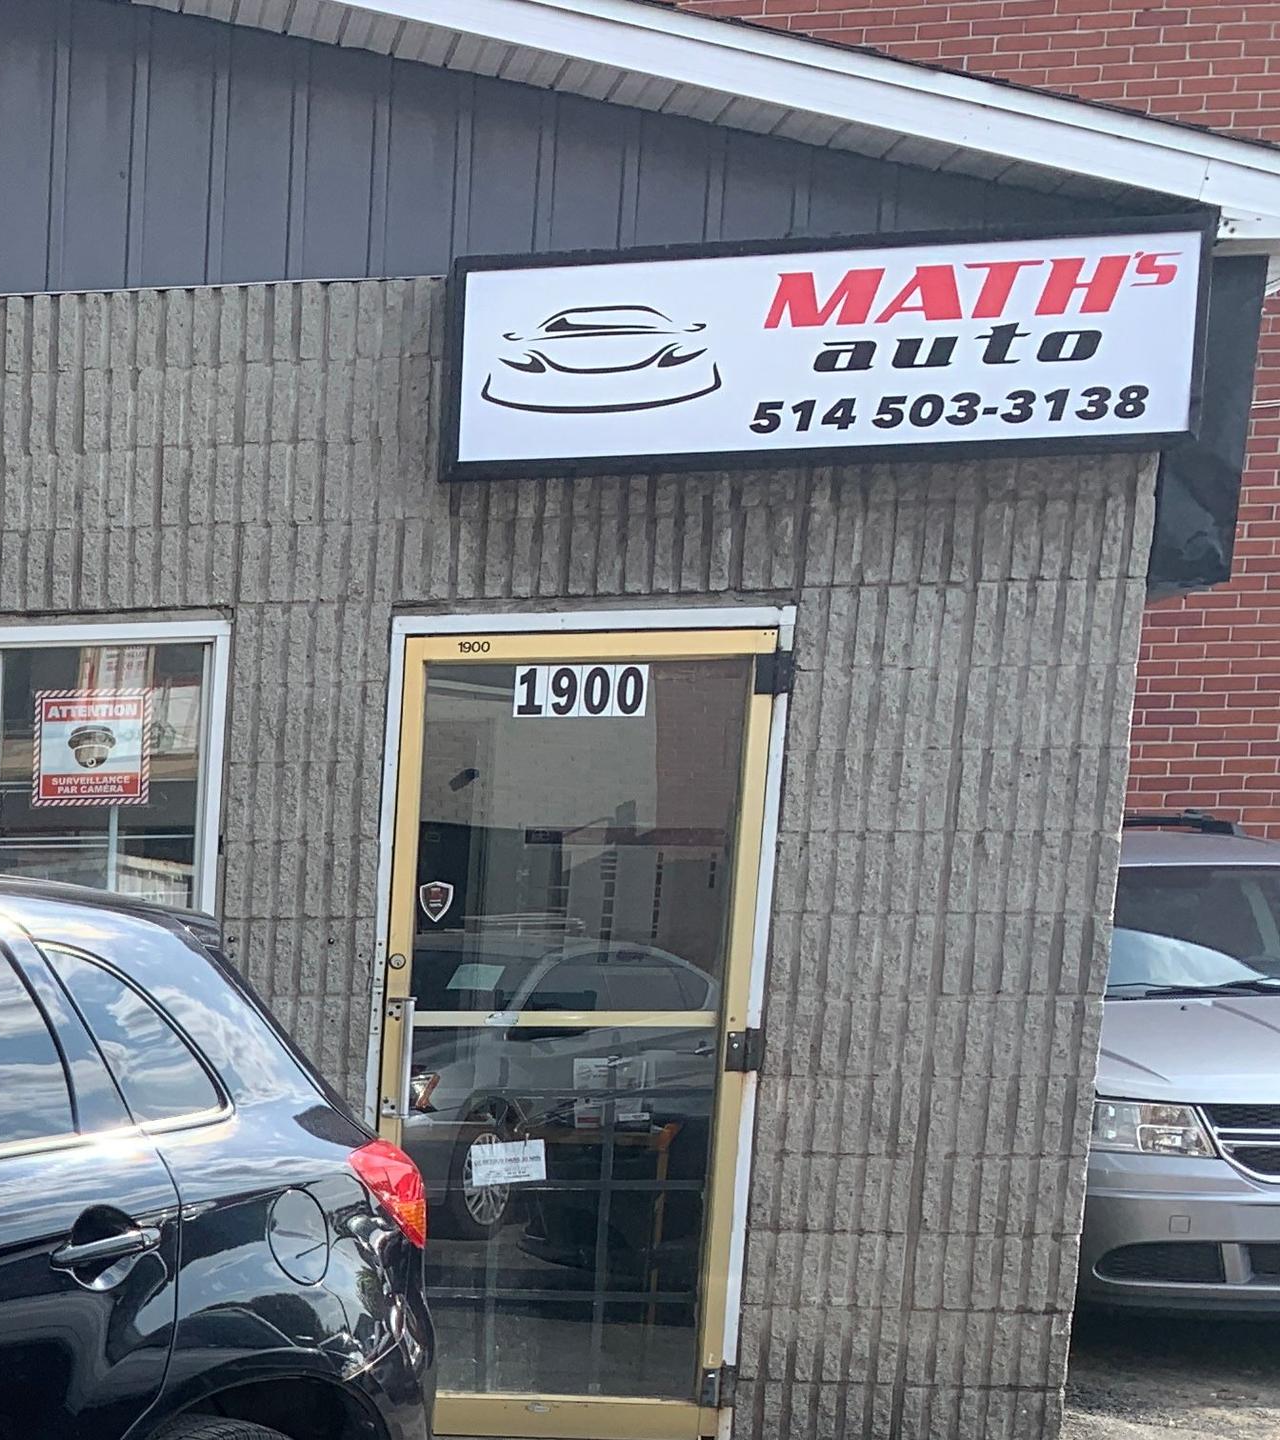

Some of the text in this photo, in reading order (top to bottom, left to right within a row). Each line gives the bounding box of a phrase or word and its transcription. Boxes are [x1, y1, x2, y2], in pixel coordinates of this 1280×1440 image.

[813, 322, 1102, 373] auto
[749, 384, 1150, 434] 514 503-3138
[458, 641, 491, 653] 1900
[516, 666, 645, 716] 1900
[47, 703, 138, 719] ATTENTION
[51, 775, 131, 786] SURVEILLANCE
[57, 785, 78, 794] PAR
